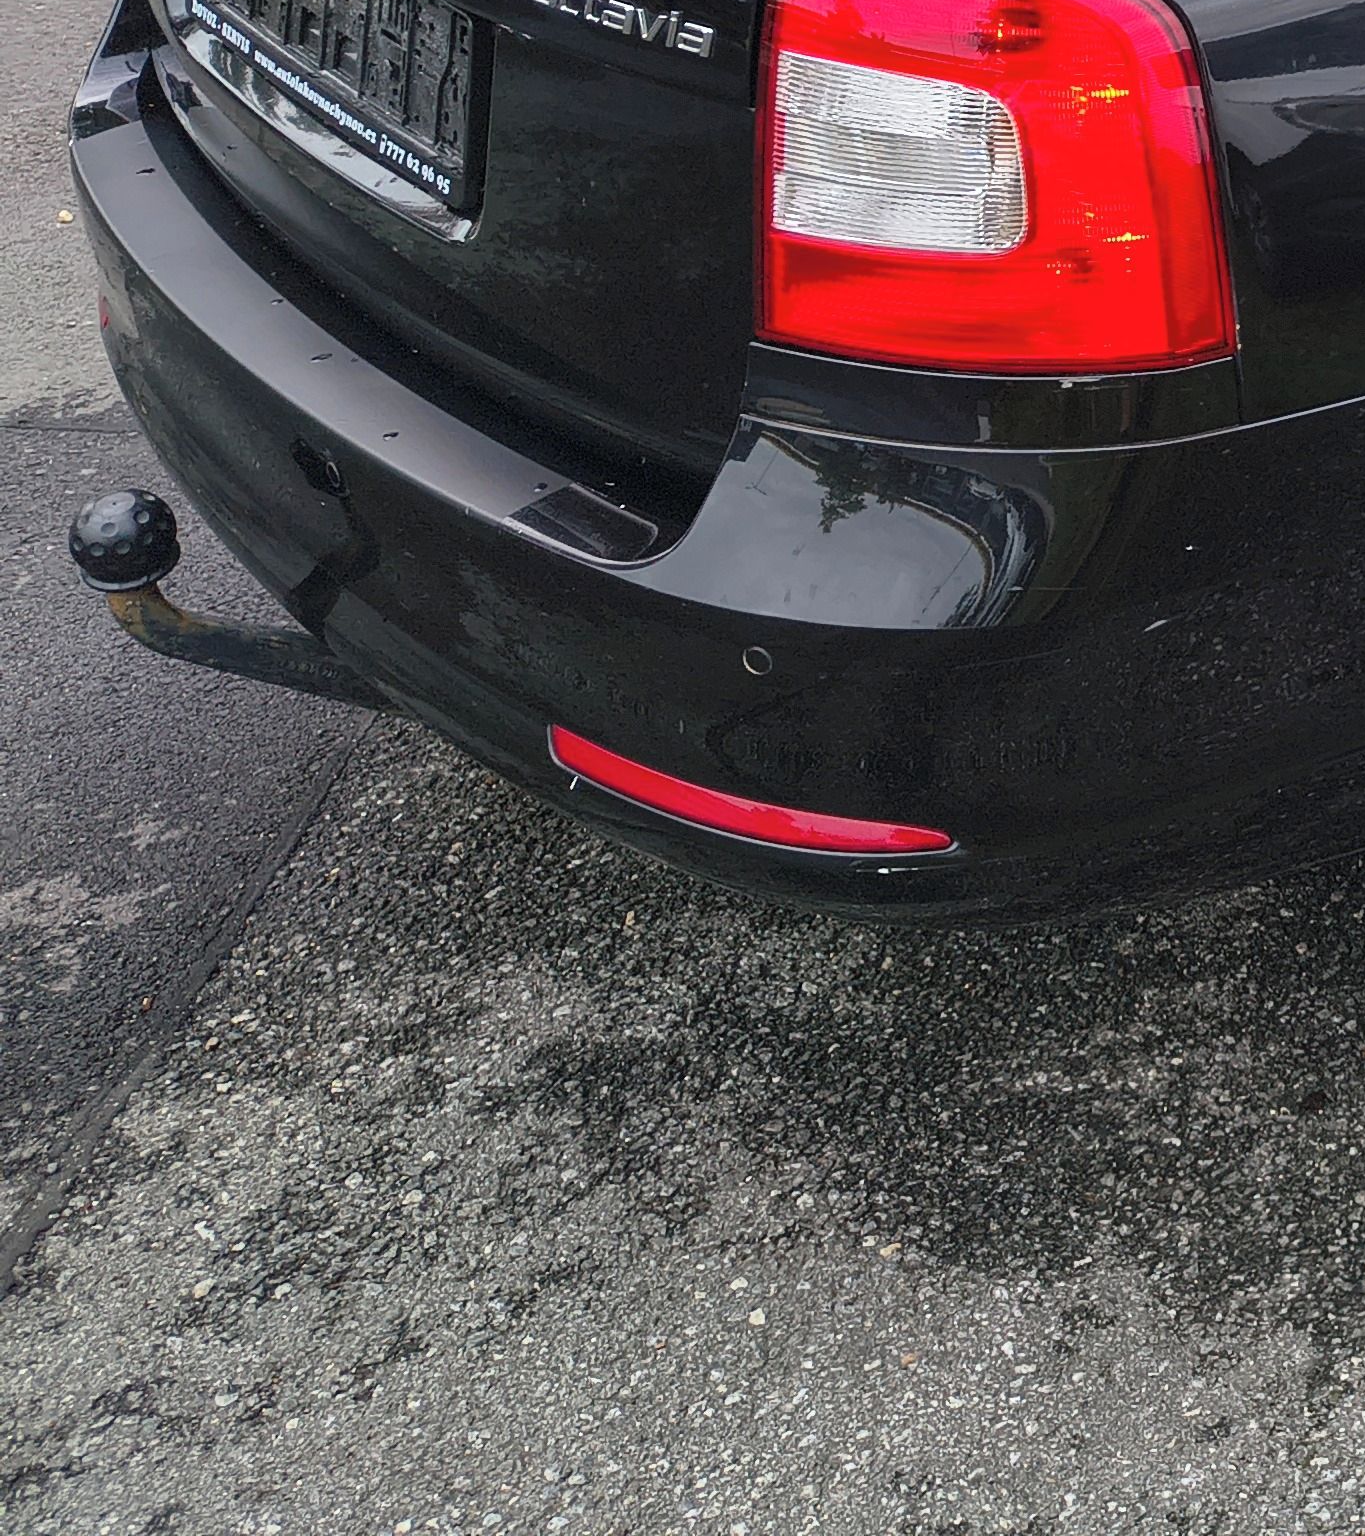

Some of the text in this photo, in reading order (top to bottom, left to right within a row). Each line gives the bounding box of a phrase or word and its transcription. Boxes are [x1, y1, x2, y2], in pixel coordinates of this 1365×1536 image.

[222, 22, 251, 54] SERVIS
[386, 141, 405, 165] 777
[407, 154, 420, 174] 62
[421, 164, 434, 183] 96
[437, 174, 451, 195] 95
